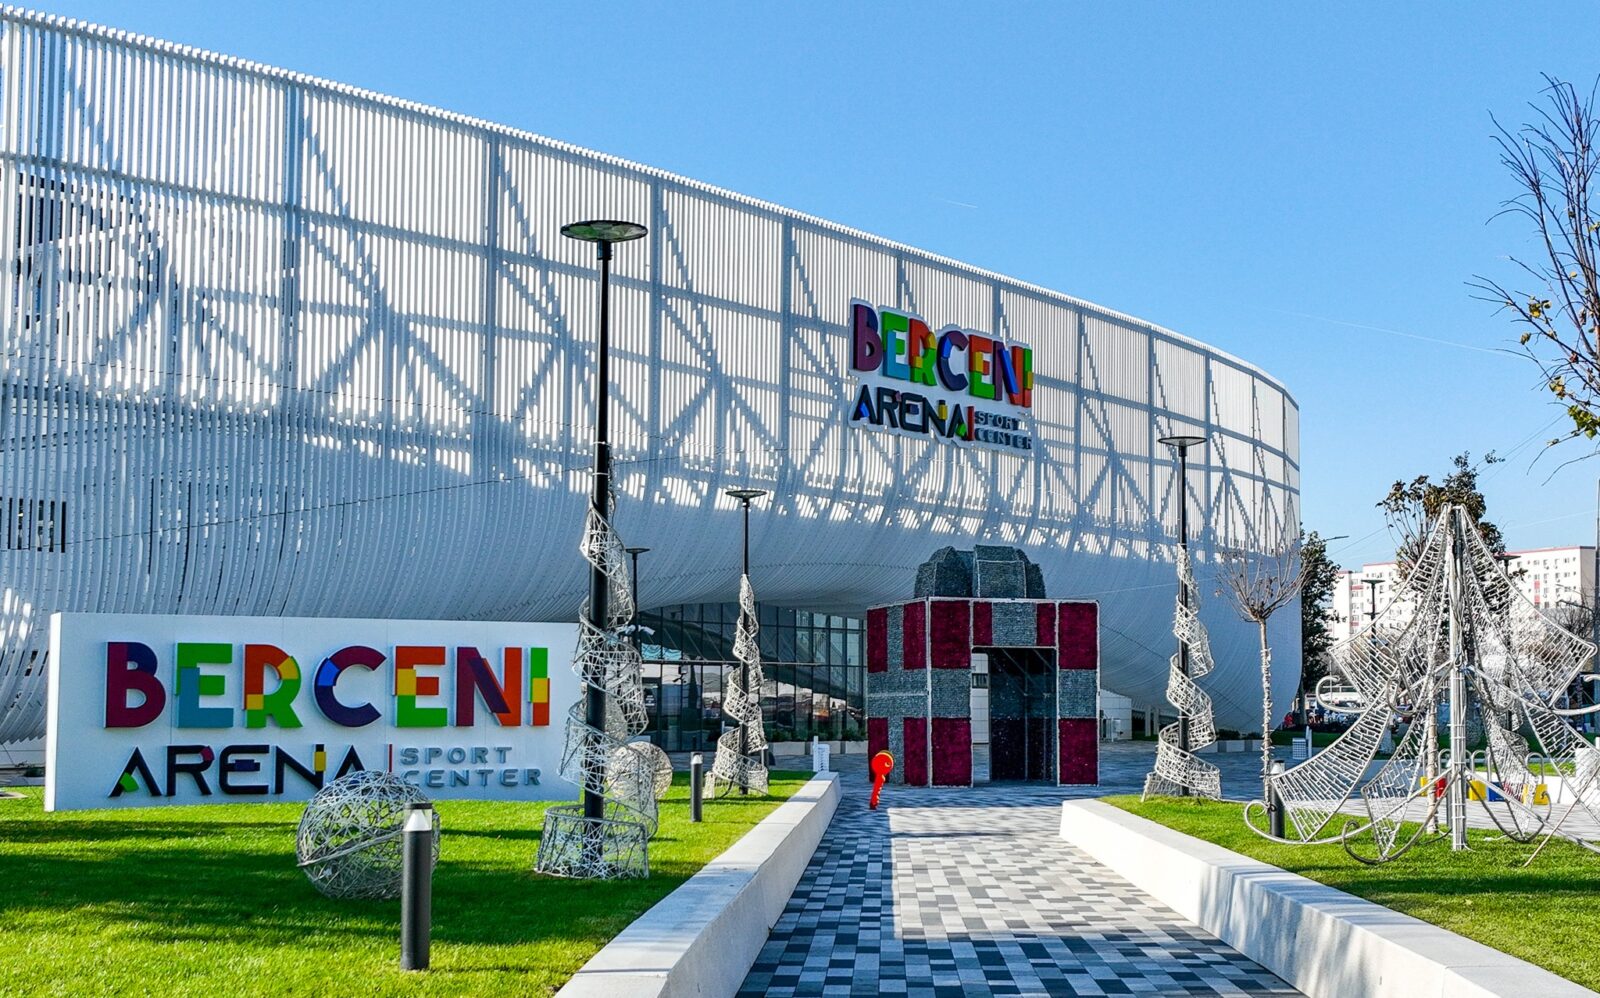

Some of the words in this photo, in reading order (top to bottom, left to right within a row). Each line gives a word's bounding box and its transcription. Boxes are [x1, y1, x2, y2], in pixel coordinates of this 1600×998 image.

[853, 303, 1033, 408] BERCENI
[852, 384, 967, 441] ARENA
[975, 411, 1021, 431] SPORT
[975, 428, 1032, 449] CENTER
[104, 641, 550, 728] BERCENI
[400, 746, 512, 765] SPORT
[402, 768, 541, 787] CENTER
